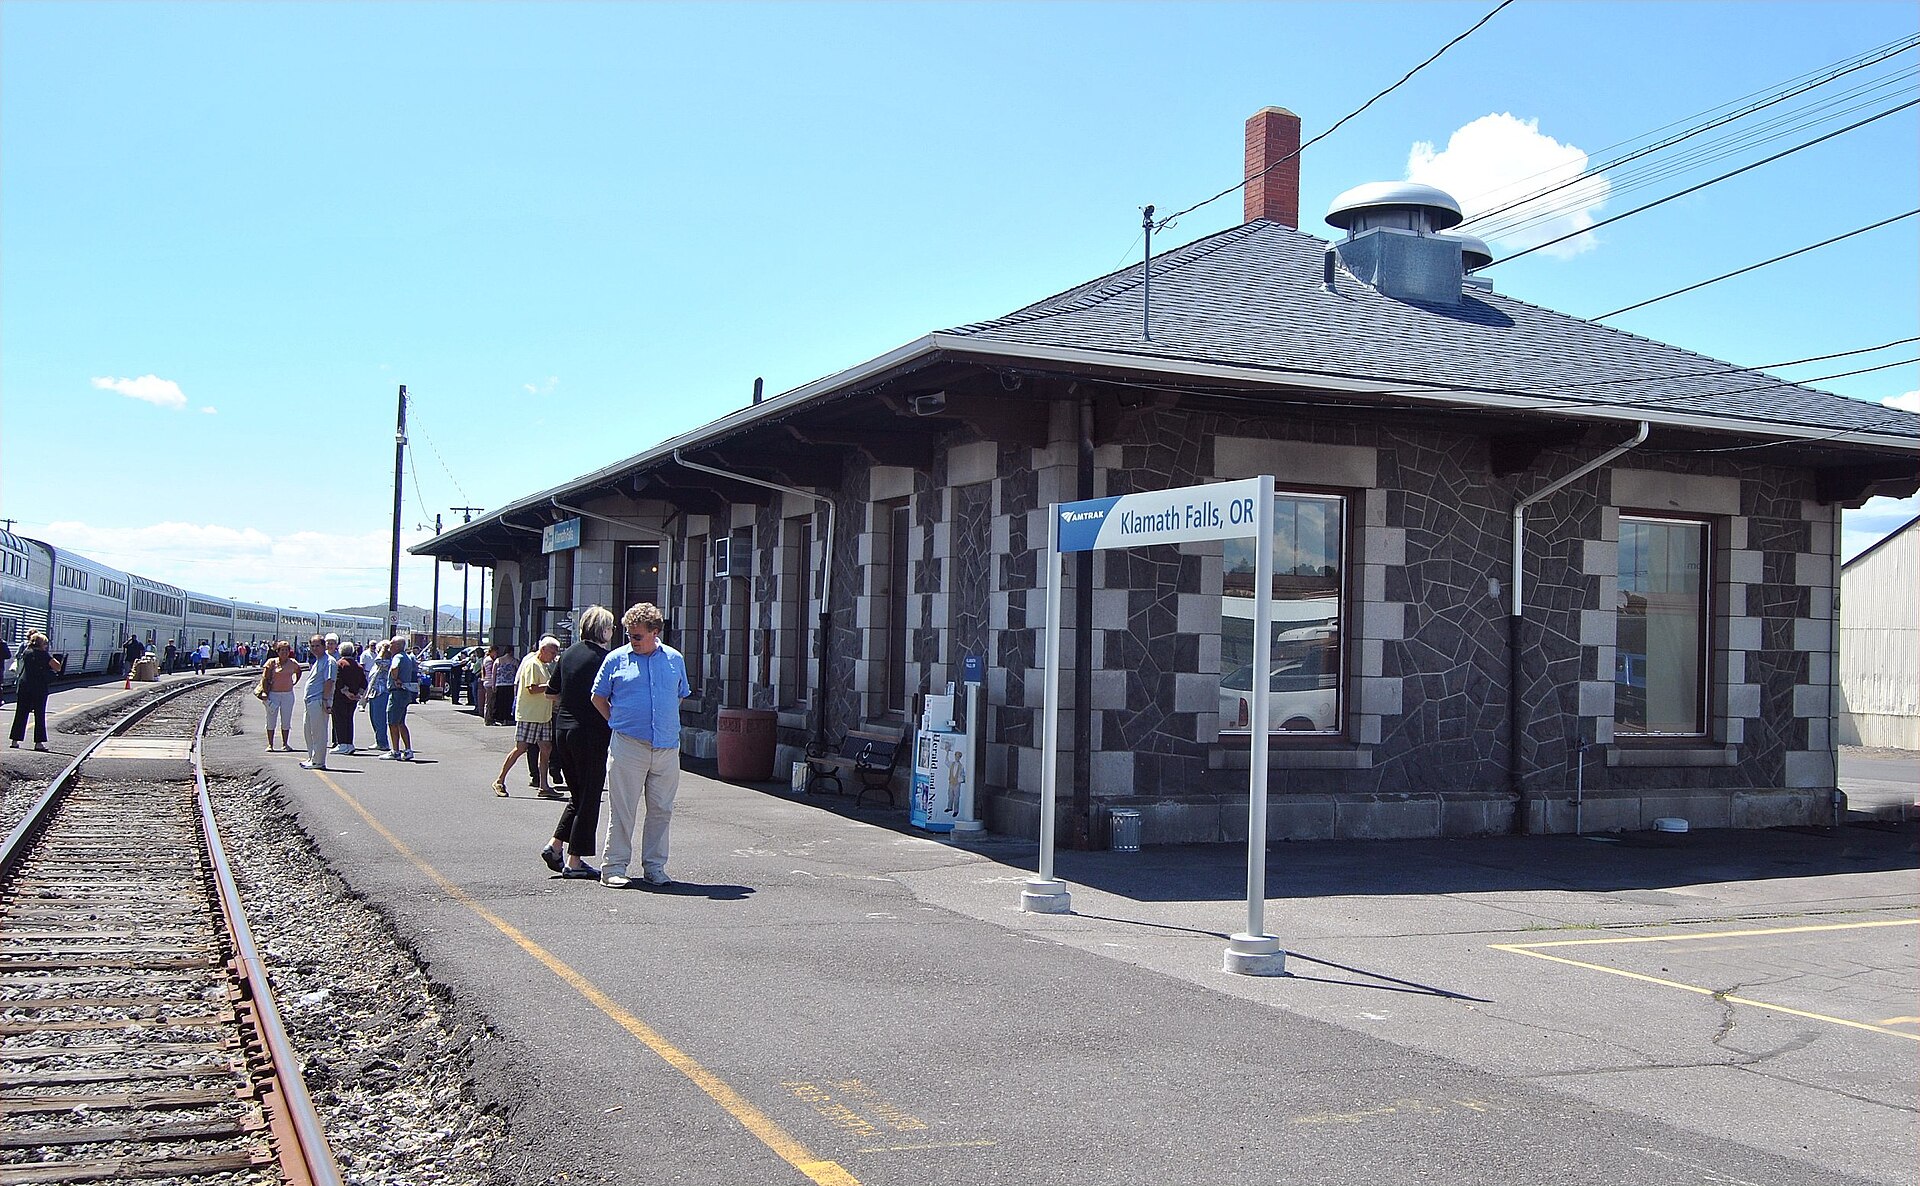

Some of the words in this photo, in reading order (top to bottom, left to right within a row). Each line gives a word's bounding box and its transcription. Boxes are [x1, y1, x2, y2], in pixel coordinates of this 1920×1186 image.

[1072, 510, 1104, 522] AMTRAK
[1121, 505, 1180, 535] Klamath
[1185, 501, 1224, 530] Falls,
[1229, 498, 1254, 524] OR
[931, 734, 940, 770] Herald
[927, 793, 936, 821] News
